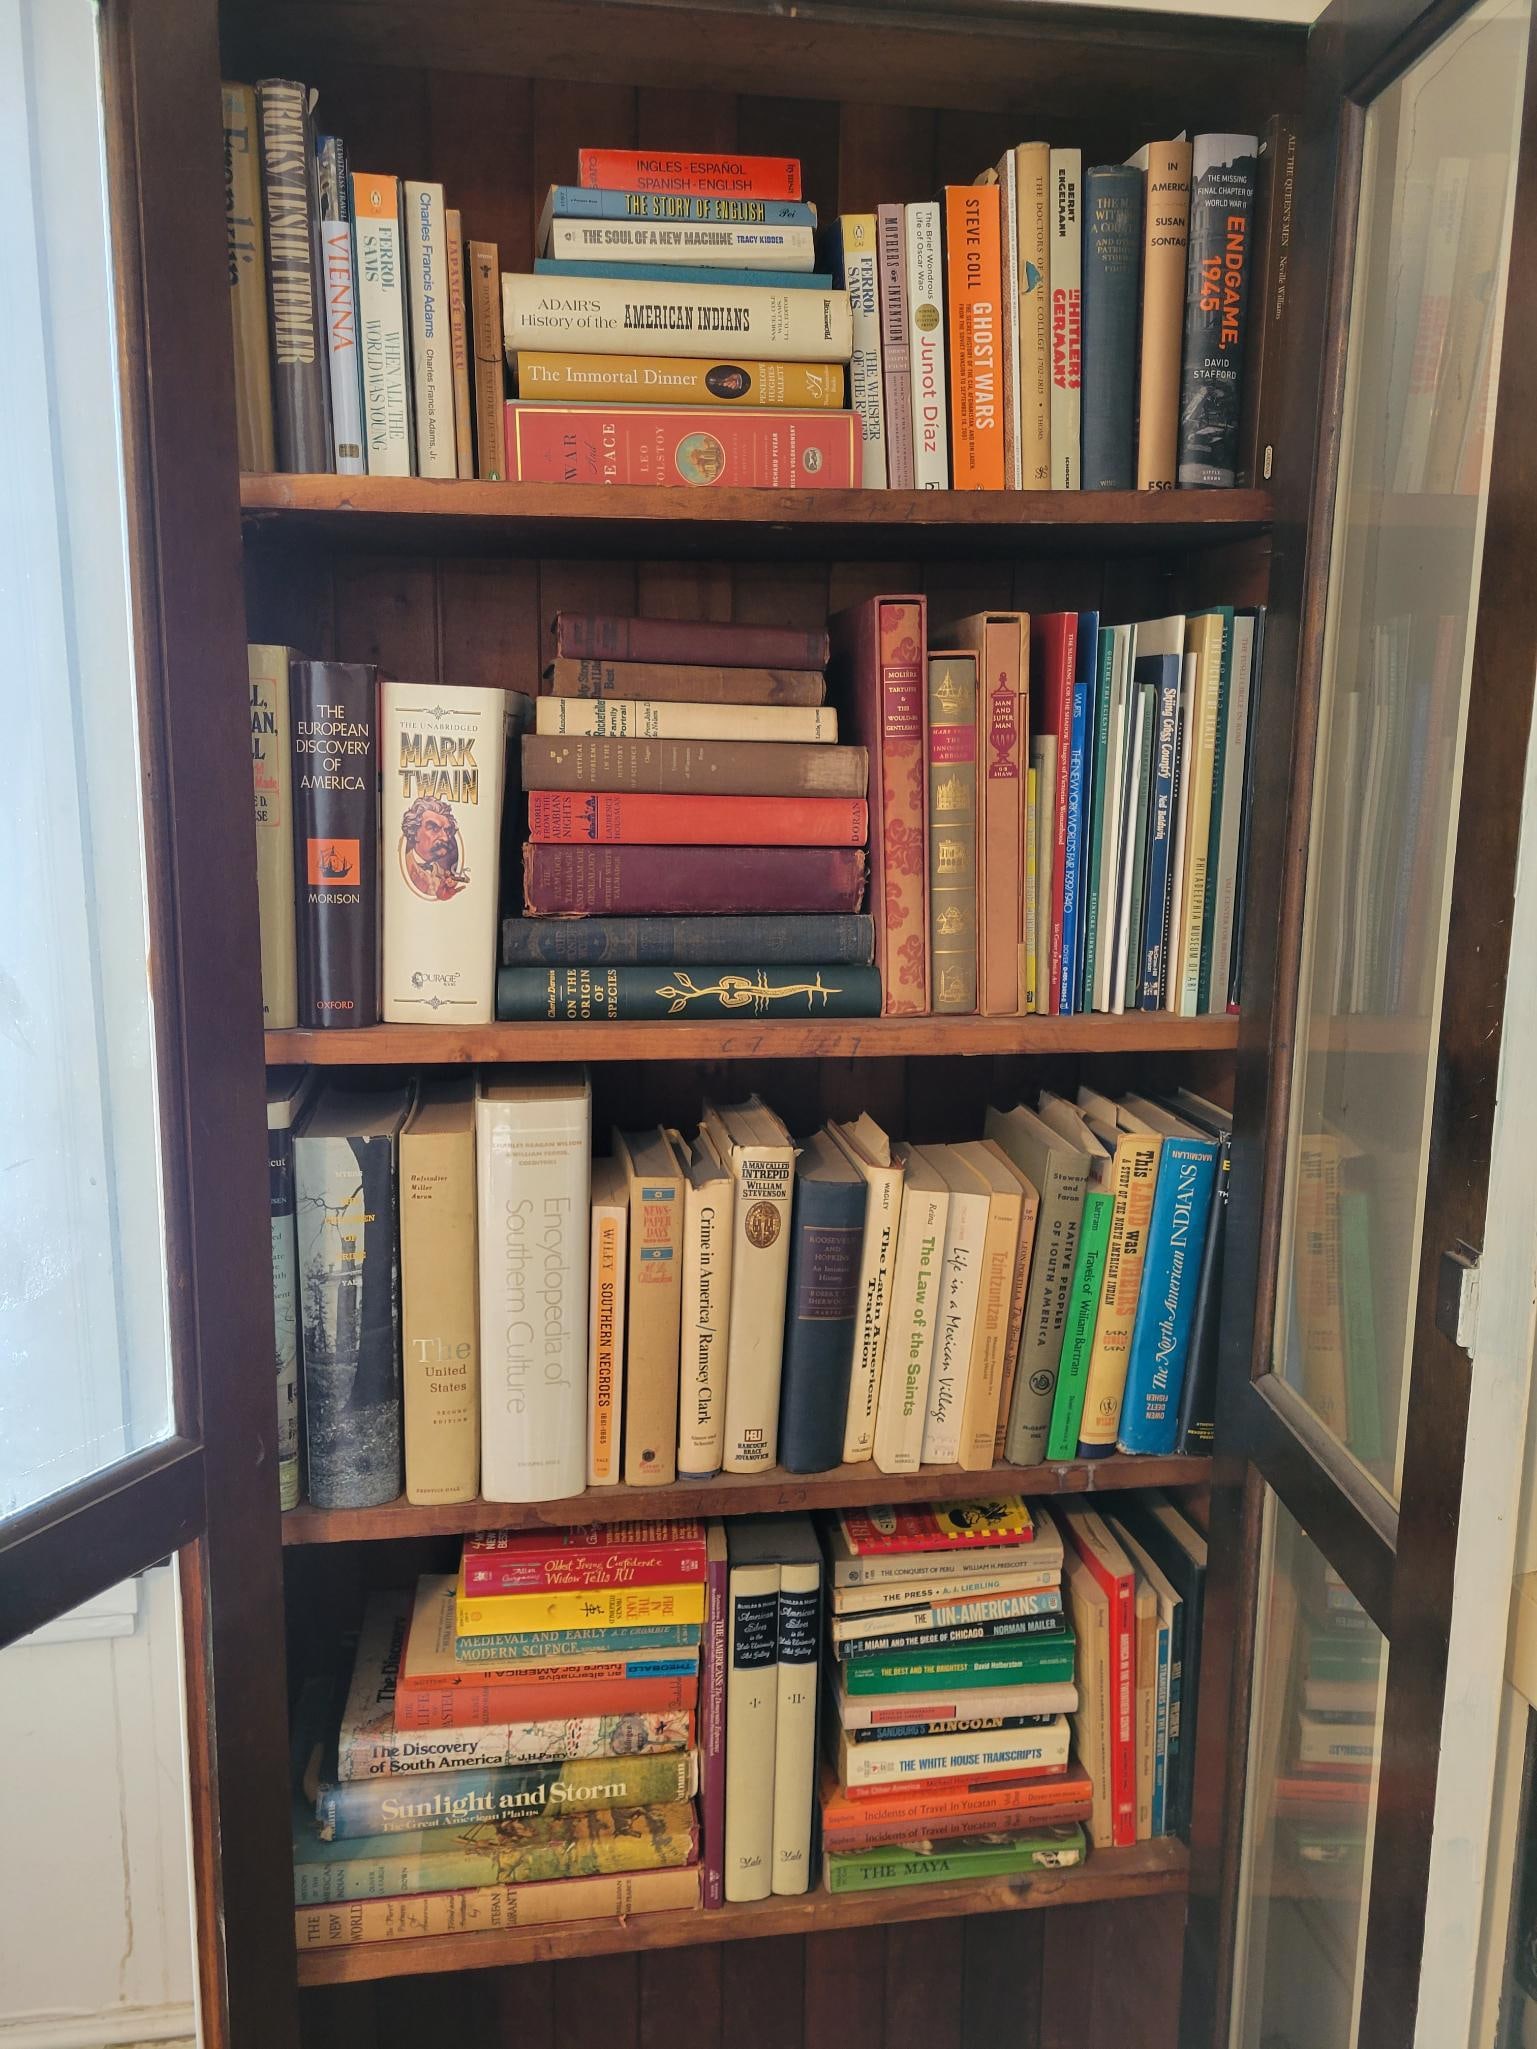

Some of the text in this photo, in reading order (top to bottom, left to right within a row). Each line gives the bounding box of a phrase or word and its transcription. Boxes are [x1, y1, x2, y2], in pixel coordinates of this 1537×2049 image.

[1167, 162, 1178, 171] IN
[1207, 174, 1248, 184] THE MISSING
[1151, 183, 1191, 193] AMERICA
[1198, 187, 1254, 197] FINAL CHAPTER OF
[624, 194, 766, 222] THE STORY OF ENGLISH
[1155, 217, 1185, 227] SUSAN
[583, 229, 733, 246] THE SOUL OF A NEW MACHINE
[736, 234, 784, 244] TRACY KIDDER
[965, 199, 983, 290] STEVE COLL
[1151, 237, 1186, 248] SONTAG
[363, 236, 379, 283] SAMS
[378, 227, 395, 292] FERROL
[420, 192, 434, 339] Charles Francis Adams
[327, 232, 354, 352] VIENNA
[861, 257, 875, 318] FERROL
[1200, 255, 1222, 311] 1945
[538, 298, 601, 312] ADAIR'S
[623, 304, 750, 332] AMERICAN INDIANS
[521, 313, 617, 330] History of the
[1052, 288, 1066, 389] GERMANY
[528, 365, 698, 386] The Immortal Dinner
[921, 336, 937, 399] Junot
[973, 302, 995, 430] GHOST WARS
[1193, 370, 1237, 380] STAFFORD
[1204, 358, 1230, 368] DAVID
[866, 350, 881, 441] THE WHISPER
[923, 405, 938, 453] Díaz
[640, 444, 649, 473] LEO
[316, 704, 345, 719] THE
[610, 706, 618, 738] Family
[619, 704, 627, 738] Portrait
[298, 721, 369, 737] EUROPEAN
[399, 721, 478, 732] THE UNABRIDGED
[296, 739, 370, 755] DISCOVERY
[399, 731, 478, 768] MARK
[323, 758, 342, 772] OF
[300, 775, 365, 790] AMERICA
[398, 768, 479, 805] TWAIN
[552, 794, 560, 839] ARABIAN
[562, 796, 572, 838] NIGHTS
[852, 801, 860, 842] DORAN
[308, 893, 360, 904] MORISON
[316, 1000, 354, 1010] OXFORD
[567, 968, 577, 1019] ON THE
[581, 969, 591, 1019] ORIGIN
[594, 985, 604, 1002] OF
[608, 969, 618, 1019] SPECIES
[1133, 1150, 1155, 1178] This
[1171, 1150, 1213, 1162] MACMILLAN
[741, 1169, 790, 1180] INTREPID
[746, 1181, 783, 1190] WILLIAM
[1062, 1184, 1078, 1192] and
[742, 1190, 787, 1198] STEVENSON
[882, 1182, 891, 1211] WAGLEY
[1127, 1182, 1154, 1227] LAND
[603, 1228, 615, 1271] WILEY
[1037, 1220, 1062, 1346] OF SOUTH AMERICA
[1053, 1221, 1077, 1330] NATIVE PEOPLES
[1116, 1256, 1143, 1316] THEIRS
[1152, 1164, 1198, 1390] The North American INDIANS
[506, 1199, 534, 1415] Southern Culture
[535, 1197, 571, 1390] Encyclopedia of
[600, 1282, 613, 1347] SOUTHERN
[861, 1277, 877, 1369] Tradition
[866, 1226, 891, 1417] The Latin American
[903, 1236, 936, 1417] The Law of the Saints
[412, 1337, 472, 1364] The
[425, 1364, 467, 1378] United
[598, 1352, 611, 1407] NEGROES
[430, 1382, 467, 1393] States
[881, 1569, 893, 1577] THE
[894, 1567, 929, 1576] CONQUEST
[939, 1565, 955, 1573] PERU
[883, 1590, 933, 1602] THE PRESS
[914, 1596, 1041, 1627] THE UN-AMERICANS
[459, 1628, 607, 1647] MEDIEVAL AND EARLY
[993, 1619, 1056, 1635] NORMAN MAILER
[461, 1642, 578, 1661] MODERN SCIENCE
[881, 1663, 969, 1677] THE BEST AND THE BRIGHTEST
[974, 1661, 1023, 1671] David Halberstam
[370, 1741, 479, 1758] The Discovery
[899, 1748, 1042, 1772] THE WHITE HOUSE TRANSCRIPTS
[369, 1754, 502, 1774] of South America
[381, 1778, 628, 1821] Sunlight and Storm
[860, 1864, 896, 1881] THE
[904, 1860, 950, 1876] MAYA
[350, 1904, 363, 1942] WORLD
[491, 1892, 501, 1926] STEFAN
[308, 1915, 320, 1942] THE
[329, 1914, 341, 1940] NEW
